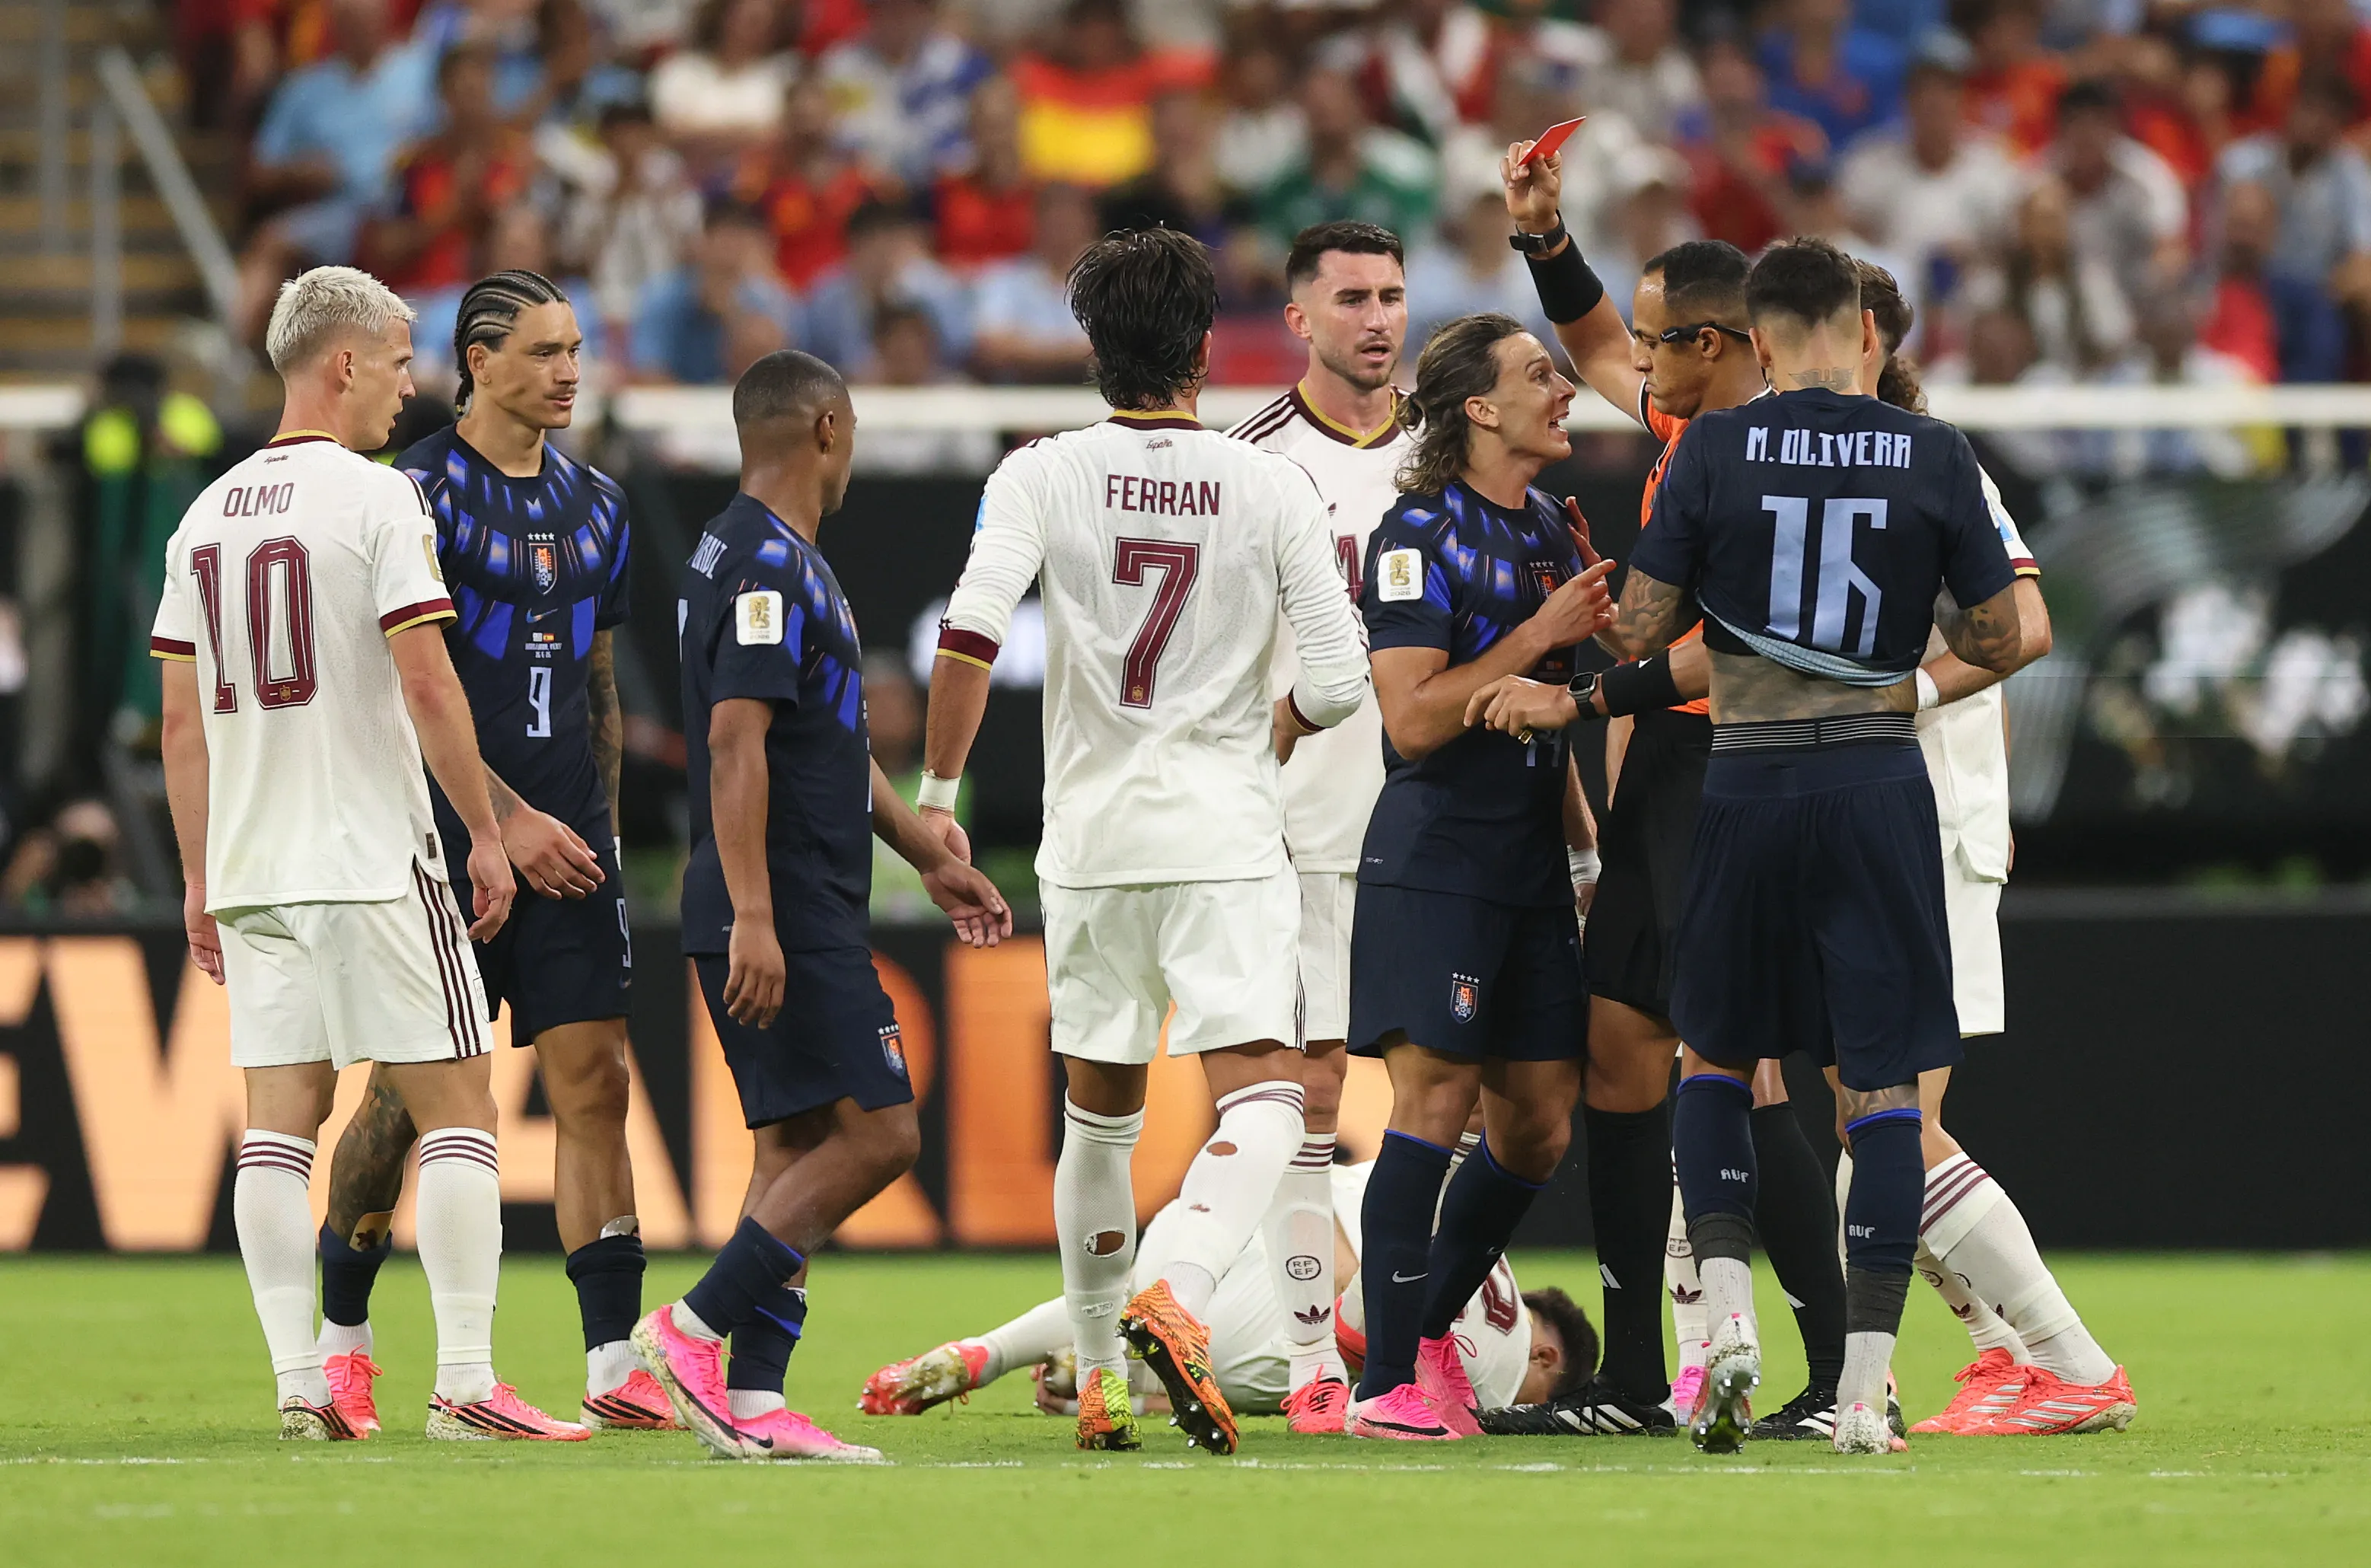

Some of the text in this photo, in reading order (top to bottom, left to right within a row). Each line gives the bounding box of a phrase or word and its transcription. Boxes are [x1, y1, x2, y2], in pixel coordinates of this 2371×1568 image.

[1746, 426, 1911, 469] M. OLIVERA
[223, 482, 295, 517] OLMO
[1106, 474, 1220, 516] FERRAN
[686, 531, 728, 580] RUZ
[1761, 495, 1888, 659] 16
[190, 535, 319, 714] 10
[1112, 536, 1200, 709] 7
[526, 666, 553, 738] 9
[616, 898, 632, 968] 9
[1720, 1168, 1749, 1184] AUF
[1849, 1224, 1875, 1239] AUF
[1293, 1260, 1313, 1268] RF
[1295, 1267, 1314, 1276] EF
